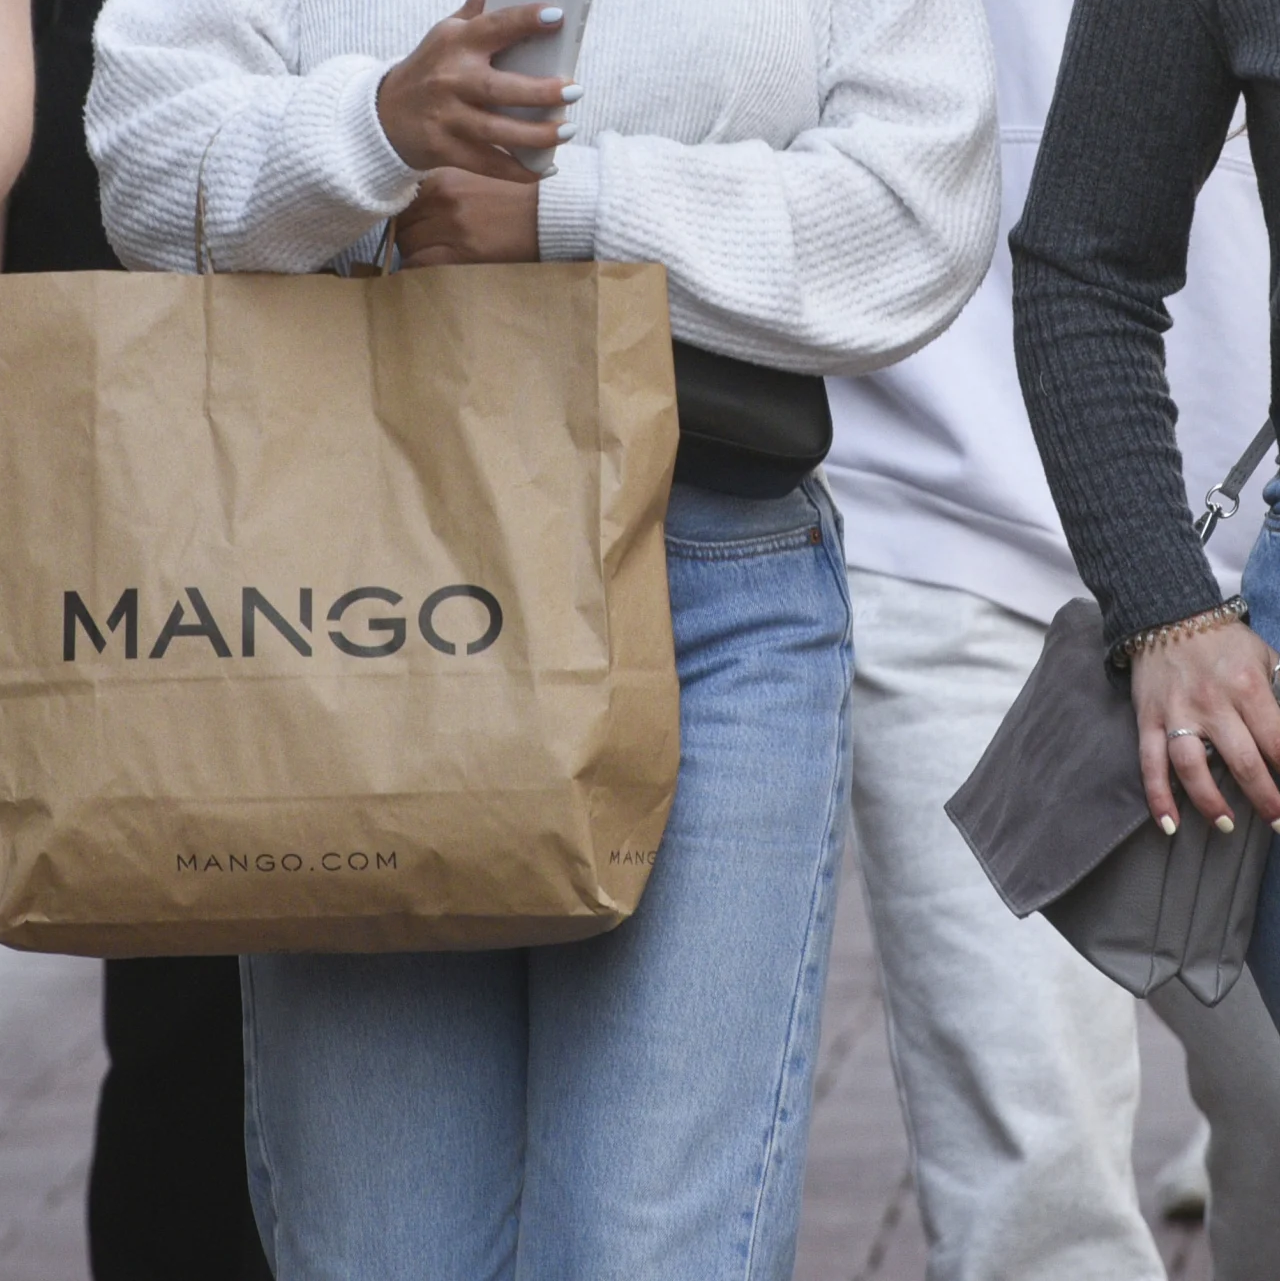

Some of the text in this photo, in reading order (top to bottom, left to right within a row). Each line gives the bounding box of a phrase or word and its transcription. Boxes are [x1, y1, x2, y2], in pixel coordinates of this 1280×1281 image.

[63, 583, 504, 662] MANGO
[175, 850, 398, 873] MANGO.COM
[608, 849, 658, 866] MANG
